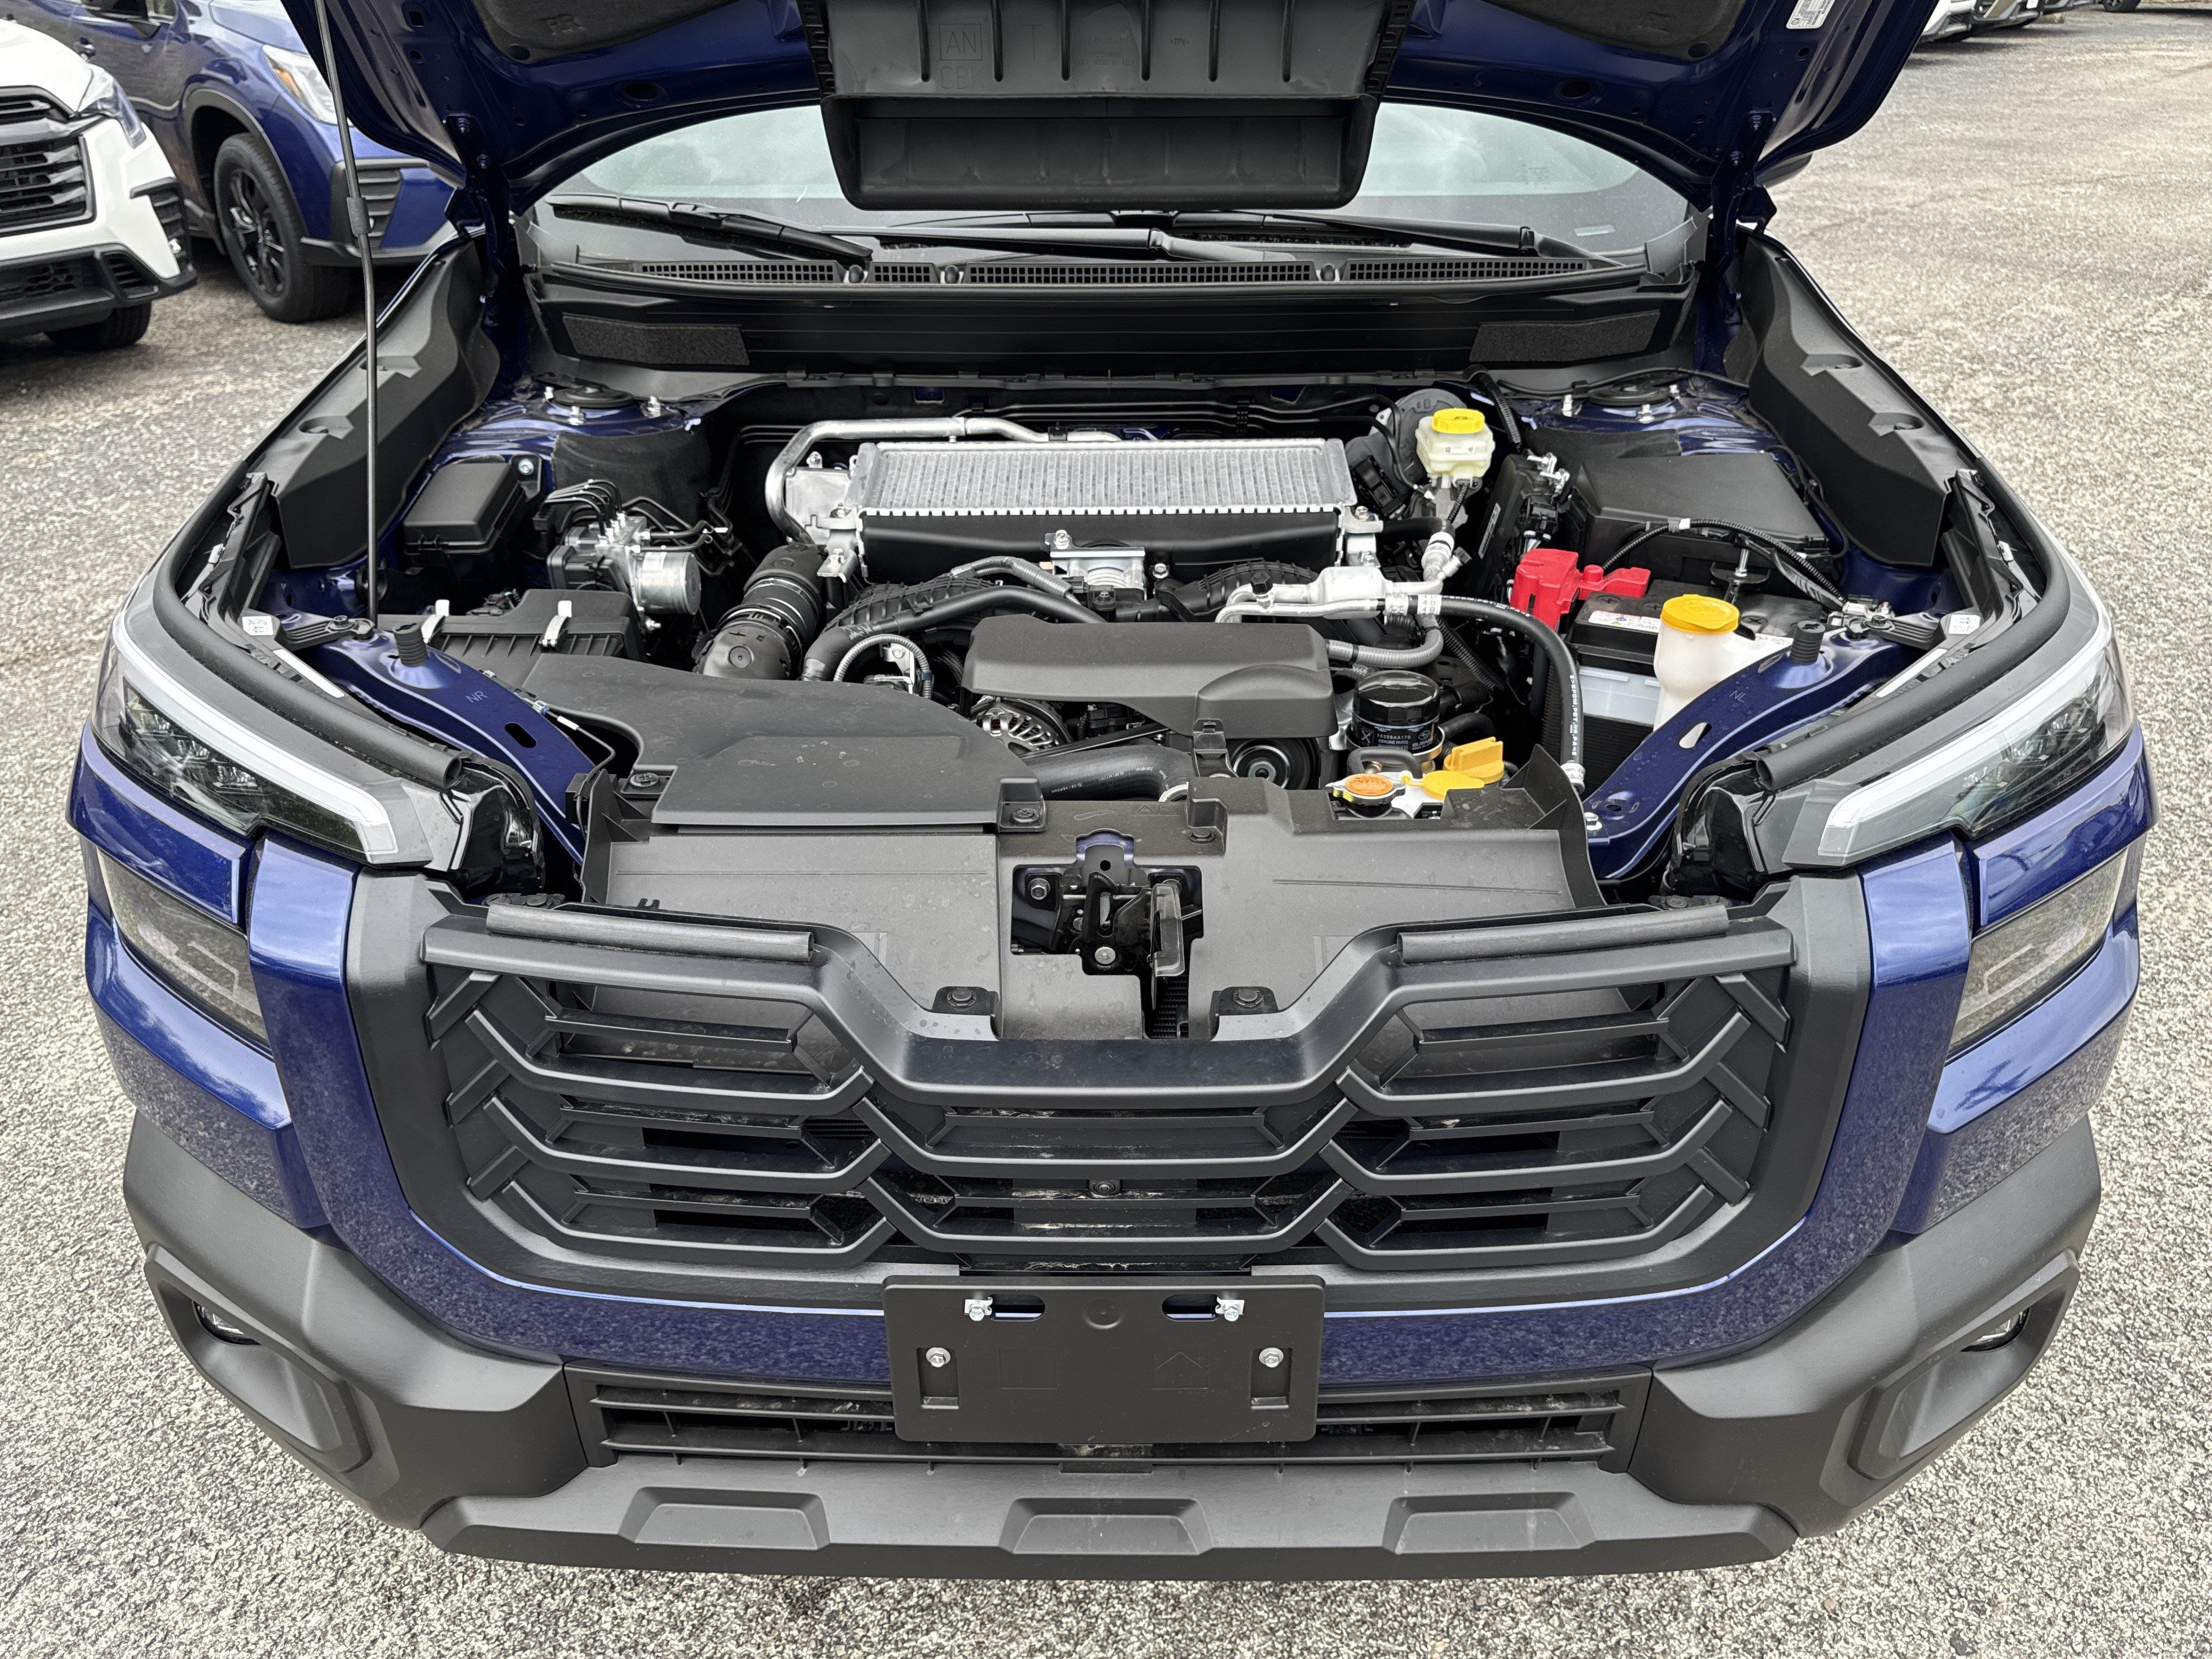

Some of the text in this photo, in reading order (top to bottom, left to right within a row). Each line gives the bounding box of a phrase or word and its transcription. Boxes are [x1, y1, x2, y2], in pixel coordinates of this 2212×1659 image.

[946, 31, 977, 54] AN
[465, 691, 488, 703] NR
[1729, 690, 1746, 703] NL
